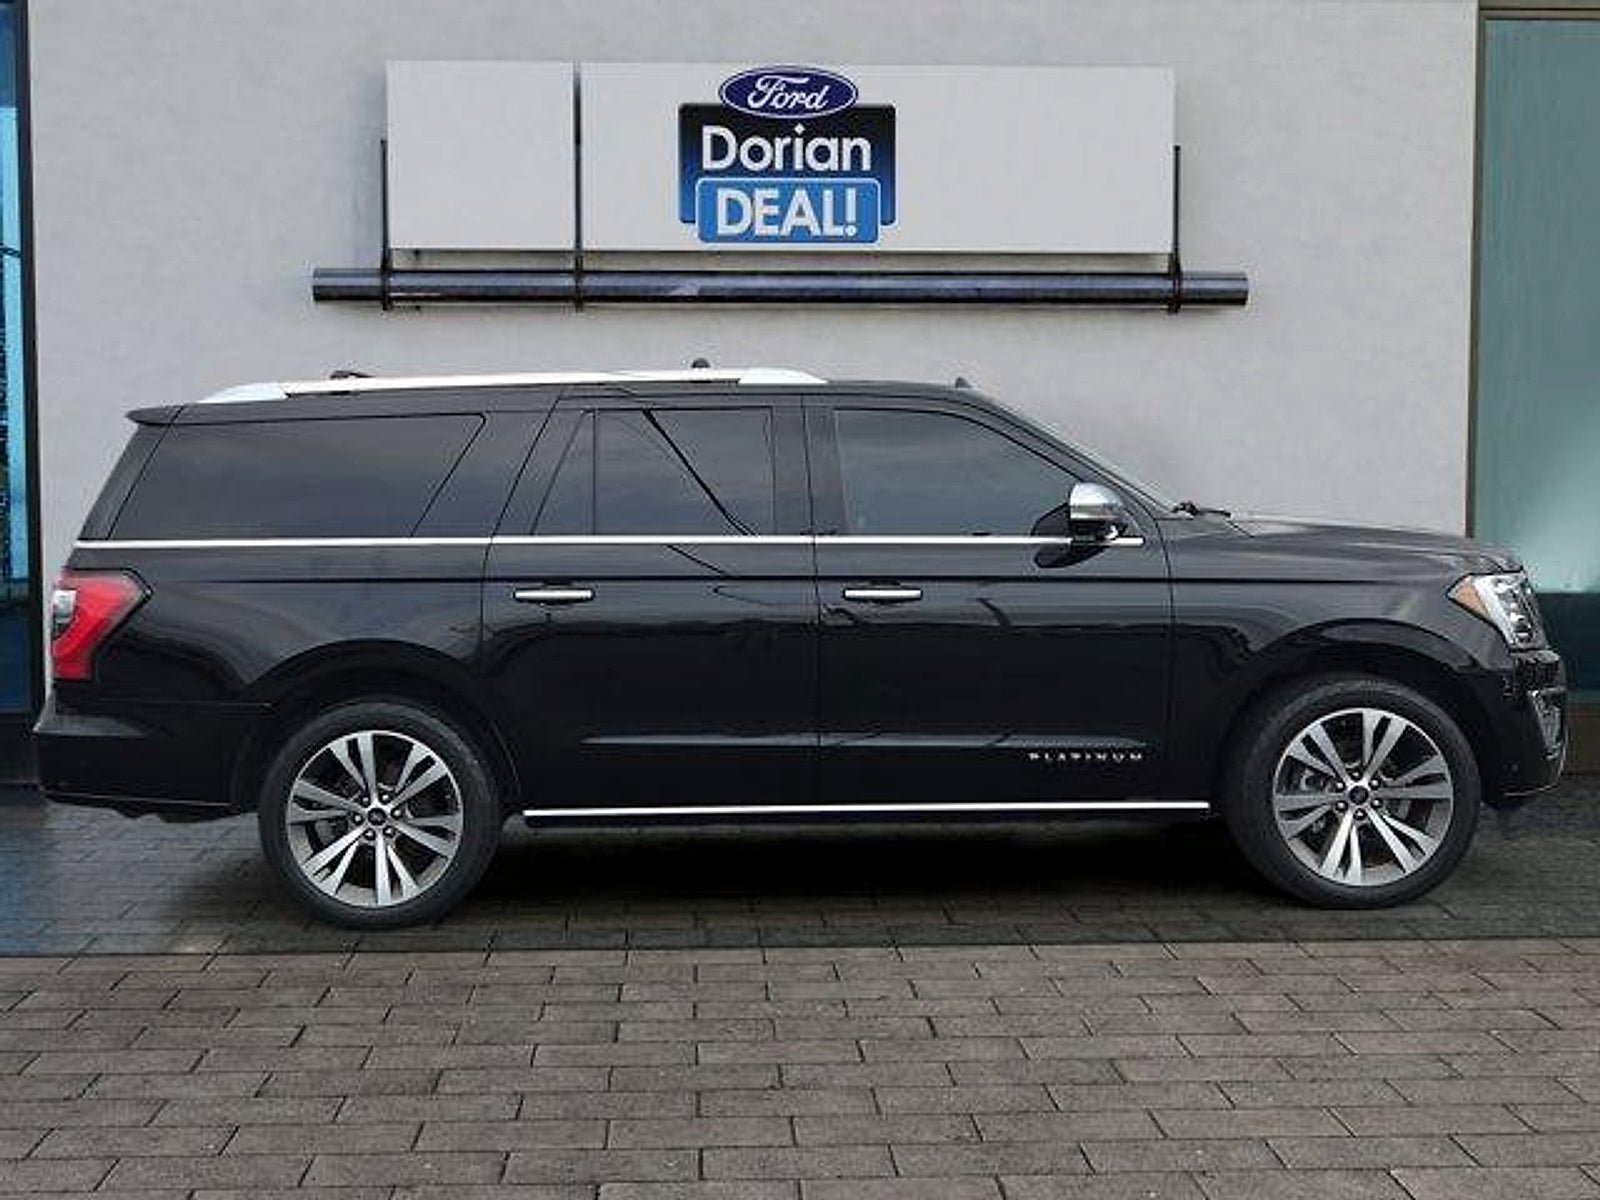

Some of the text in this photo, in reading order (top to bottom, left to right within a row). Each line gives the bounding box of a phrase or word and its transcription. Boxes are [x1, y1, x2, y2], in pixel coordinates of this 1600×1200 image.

[746, 75, 830, 110] Ford
[702, 123, 872, 171] Dorian
[716, 188, 858, 237] DEAL!
